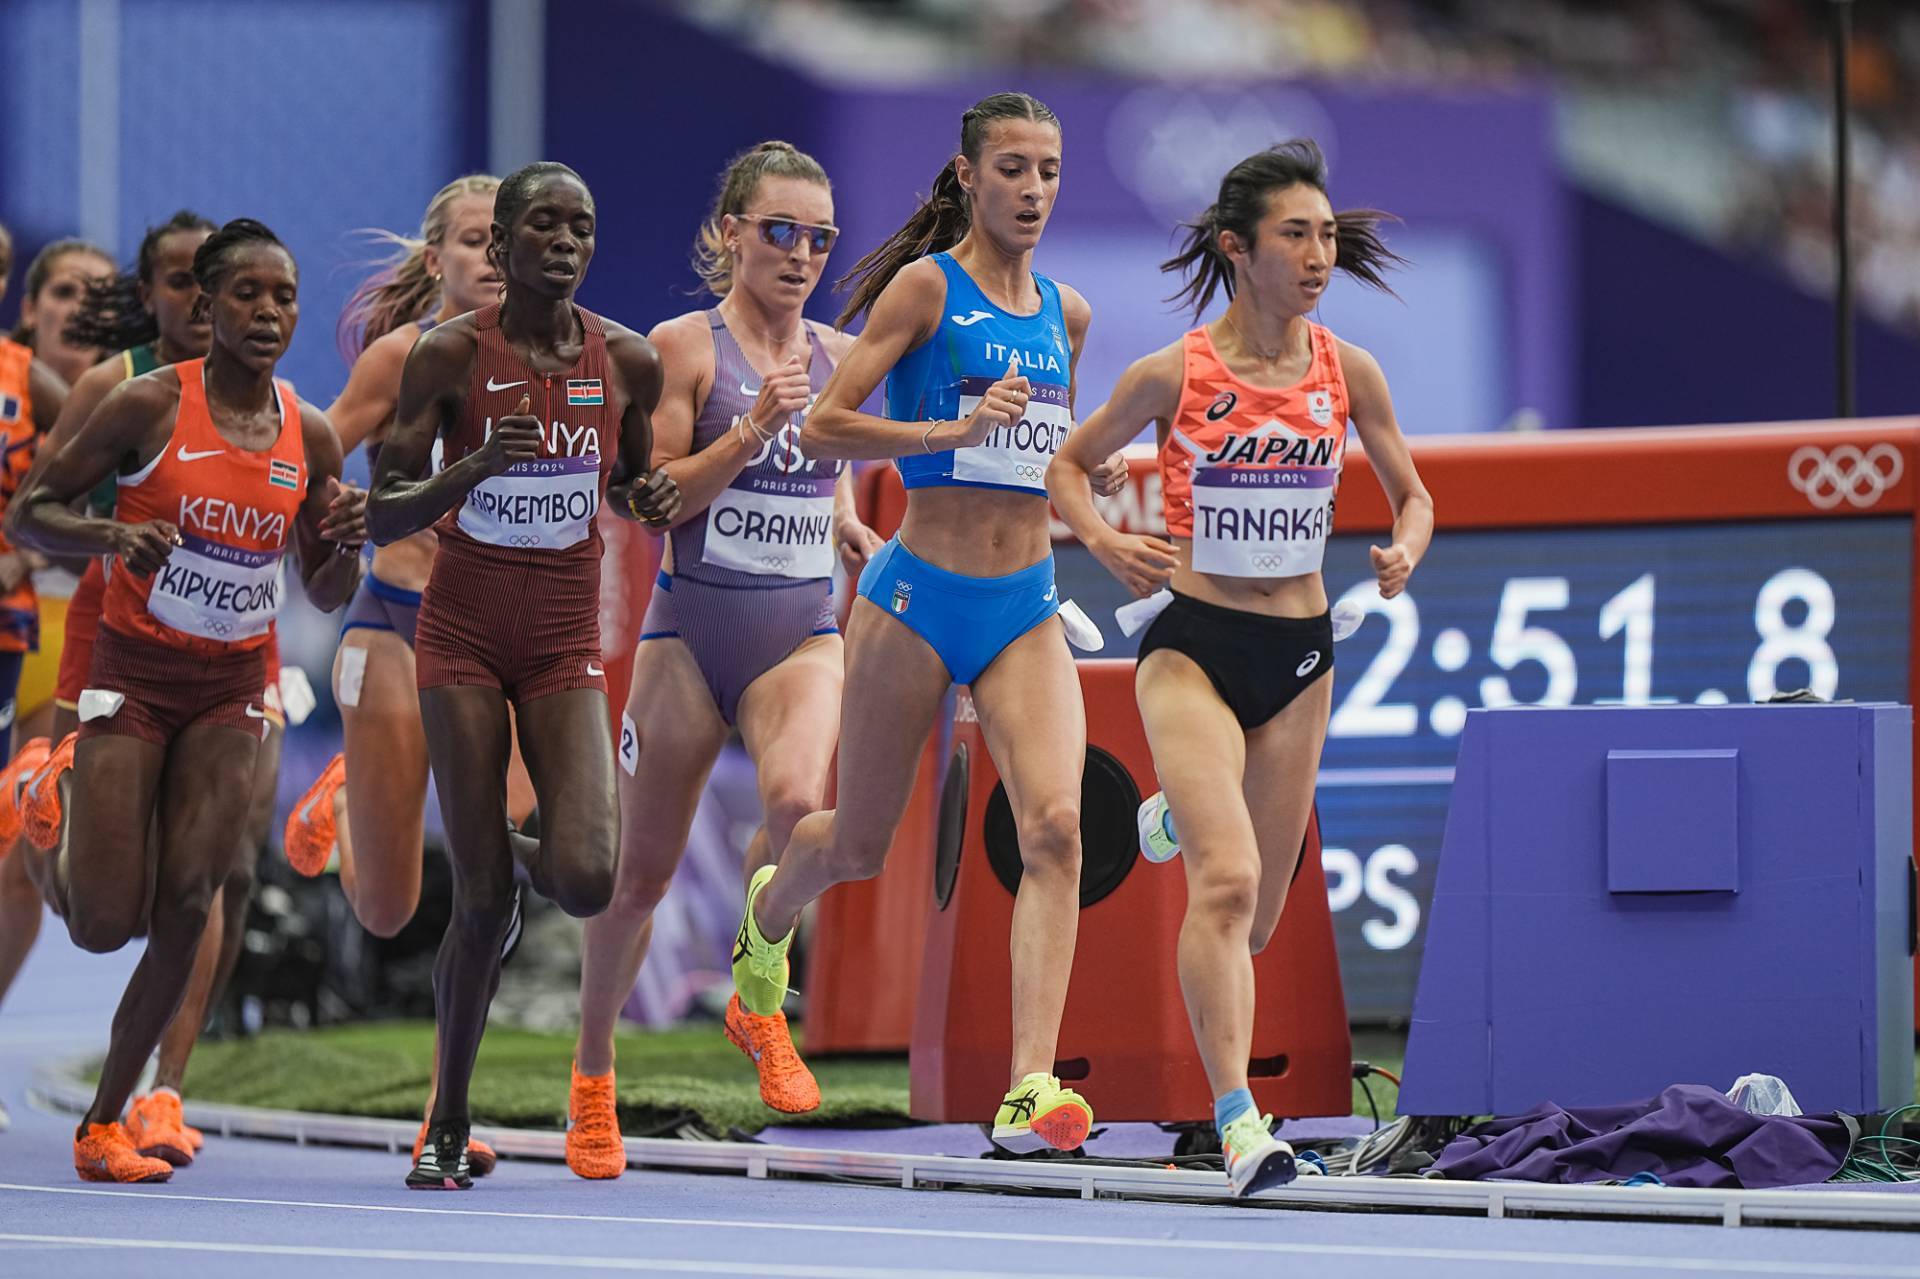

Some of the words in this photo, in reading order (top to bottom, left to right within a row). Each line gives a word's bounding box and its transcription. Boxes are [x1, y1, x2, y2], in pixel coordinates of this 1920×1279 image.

[985, 342, 1061, 374] ITALIA
[1206, 435, 1335, 466] JAPAN
[532, 462, 565, 472] 2024
[1231, 473, 1270, 484] PARIS
[1273, 473, 1308, 484] 2024
[753, 479, 788, 492] PARIS
[790, 482, 818, 494] 2024
[179, 494, 286, 547] KENYA
[713, 506, 831, 545] CRANNY
[1198, 505, 1323, 541] TANAKA
[204, 542, 241, 561] PARIS
[621, 727, 634, 760] 2
